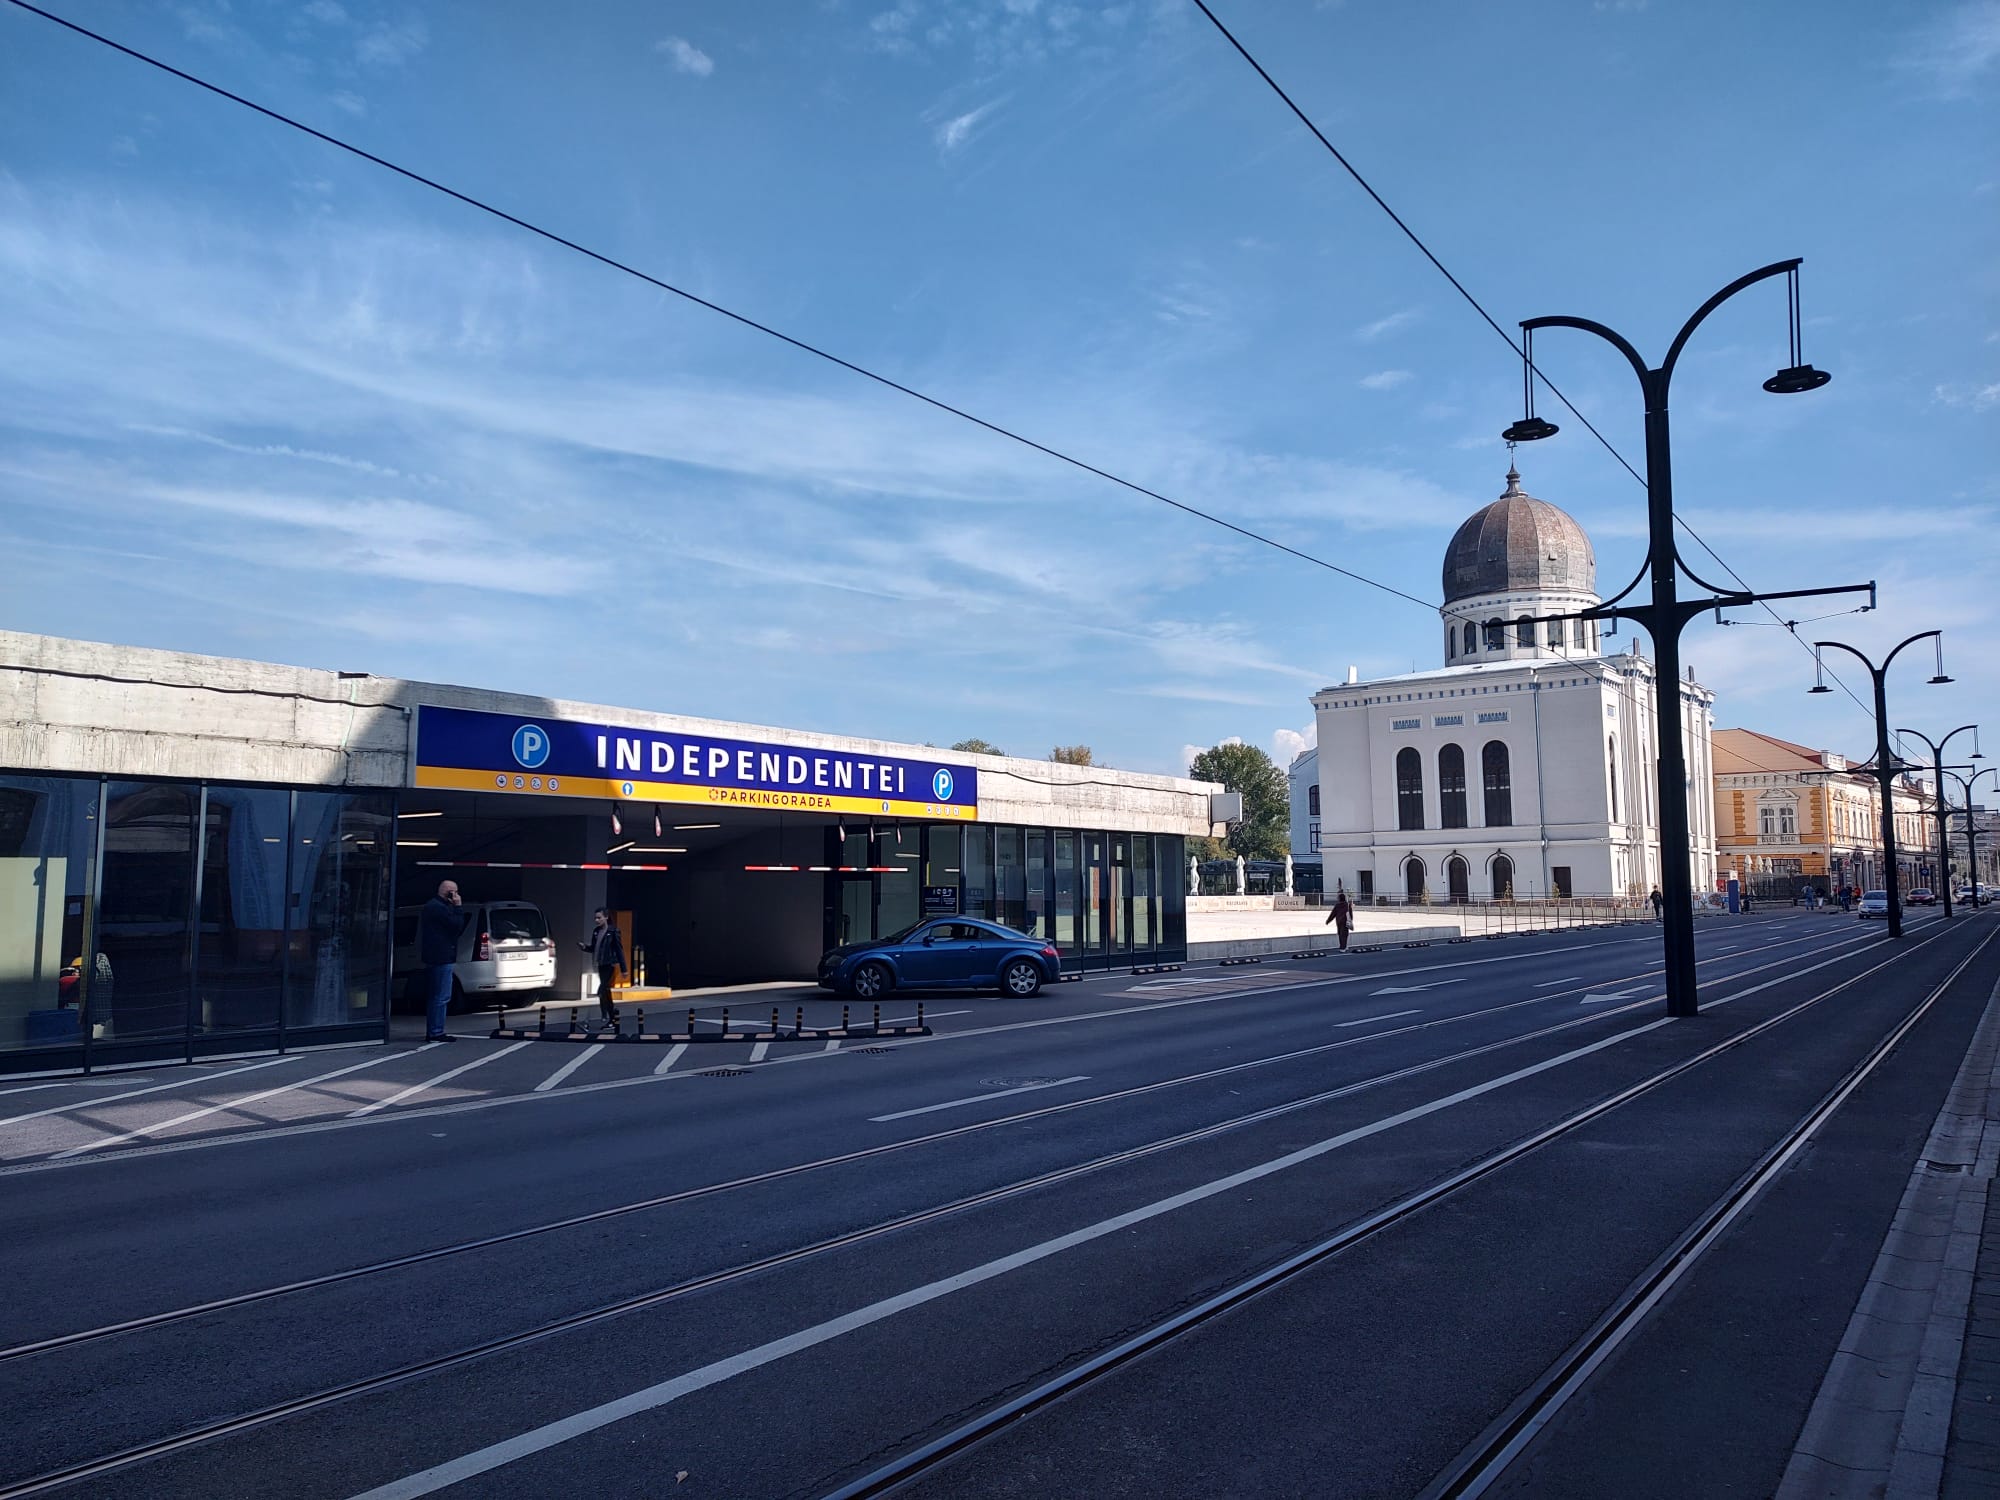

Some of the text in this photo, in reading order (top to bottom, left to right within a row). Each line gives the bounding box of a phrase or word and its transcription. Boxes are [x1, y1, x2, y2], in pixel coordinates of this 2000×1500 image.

[523, 731, 542, 761] P
[597, 735, 905, 793] INDEPENDENTEI
[938, 773, 950, 795] P
[721, 790, 832, 808] PARKINGORADEA
